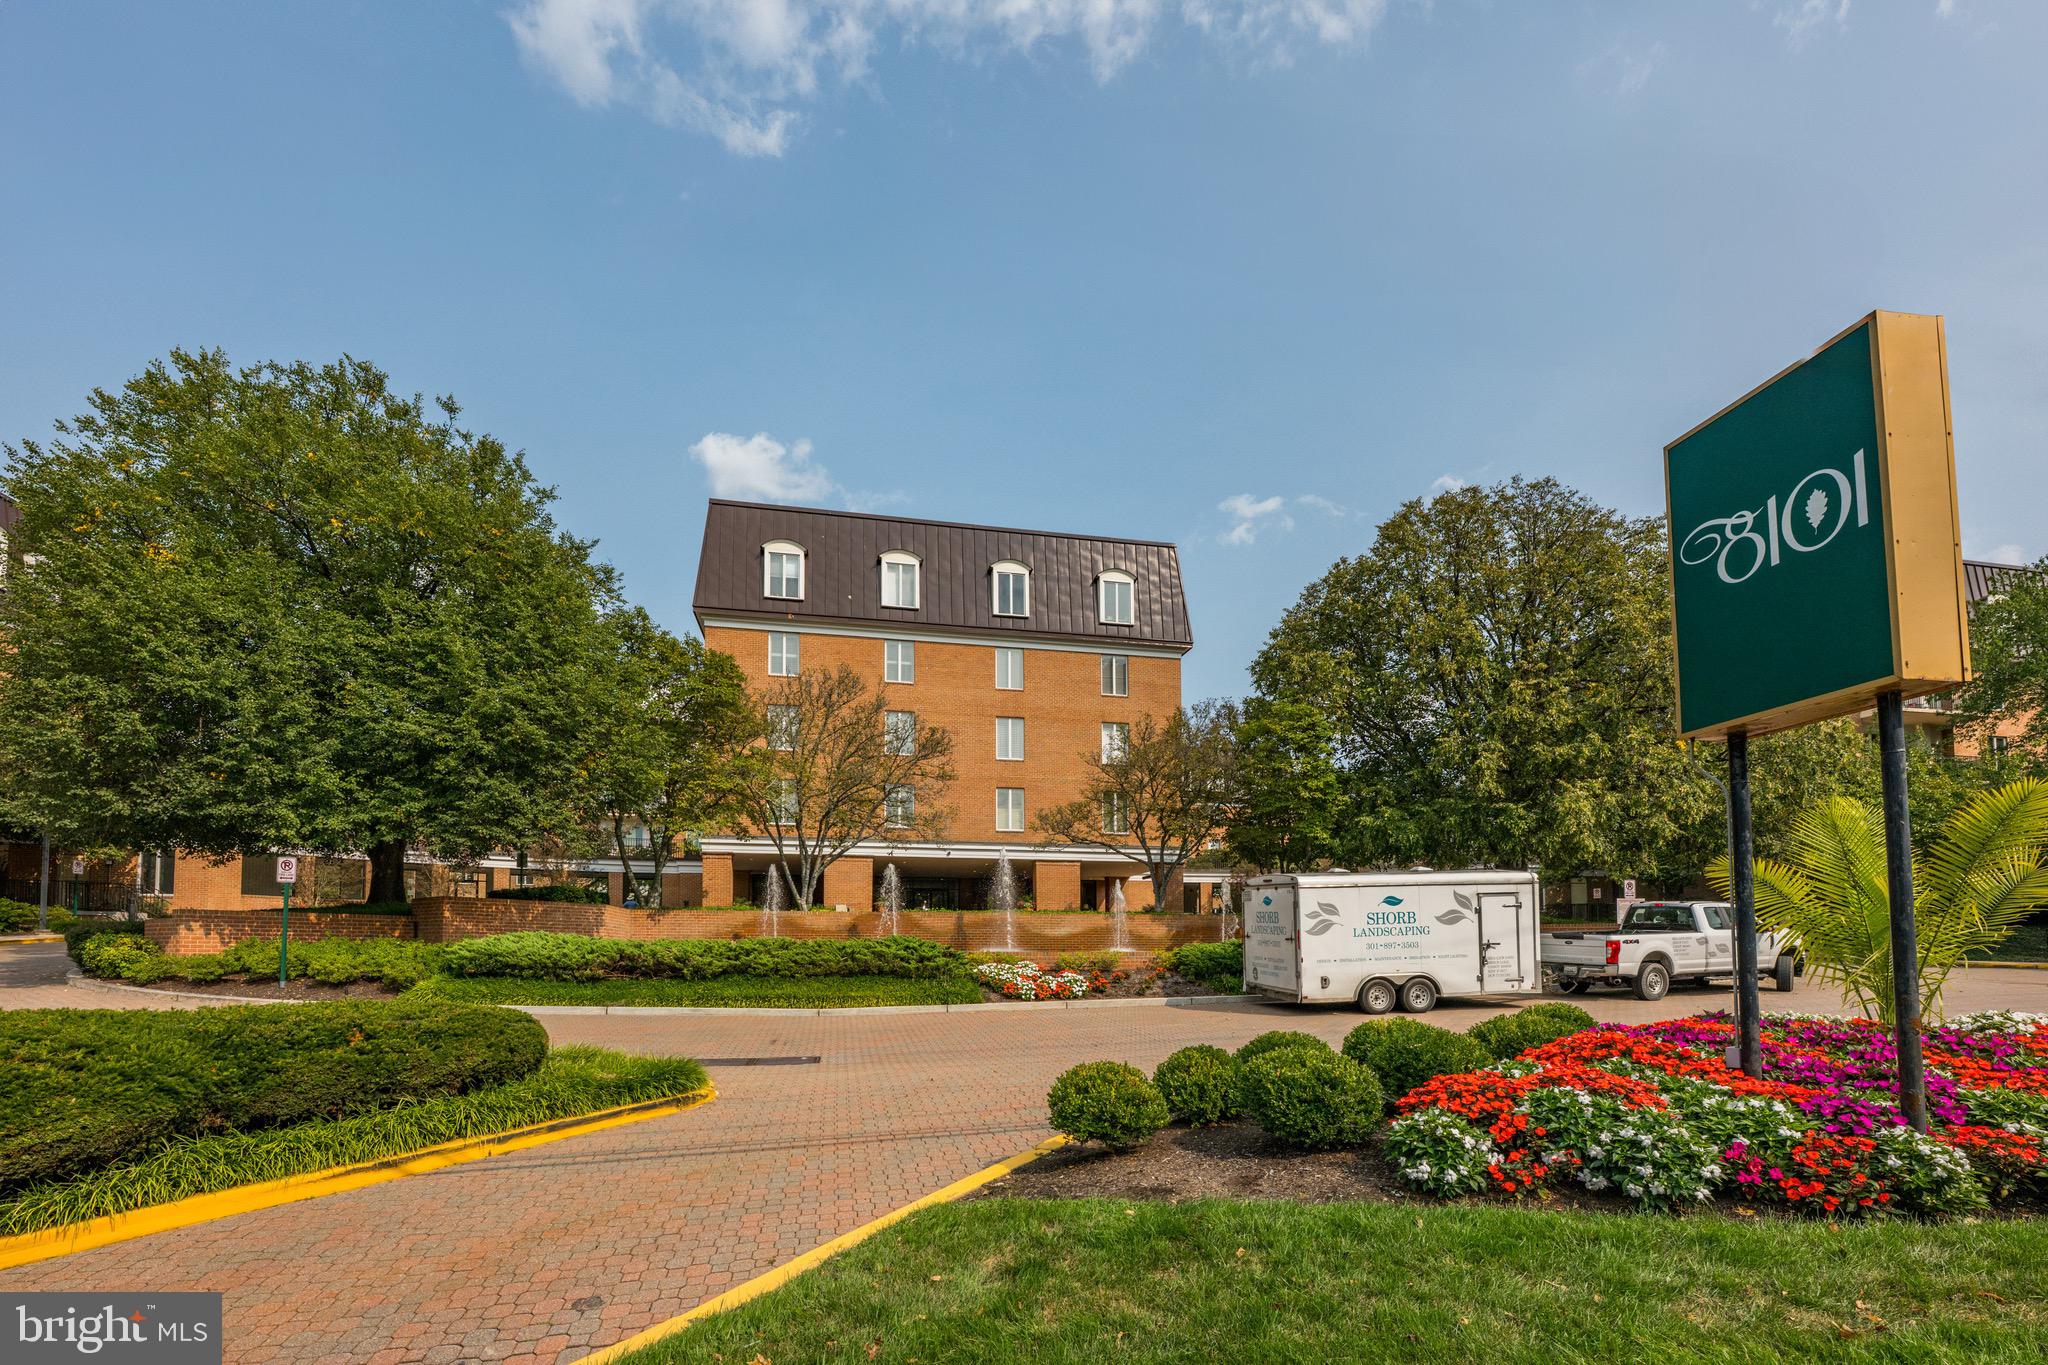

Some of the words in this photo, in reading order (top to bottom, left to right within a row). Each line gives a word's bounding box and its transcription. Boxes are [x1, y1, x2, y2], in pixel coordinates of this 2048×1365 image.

[1680, 448, 1868, 583] 8101
[1256, 911, 1280, 924] SHORB
[1366, 911, 1417, 925] SHORB
[1251, 925, 1287, 935] LANDSCAPING
[1353, 925, 1430, 937] LANDSCAPING
